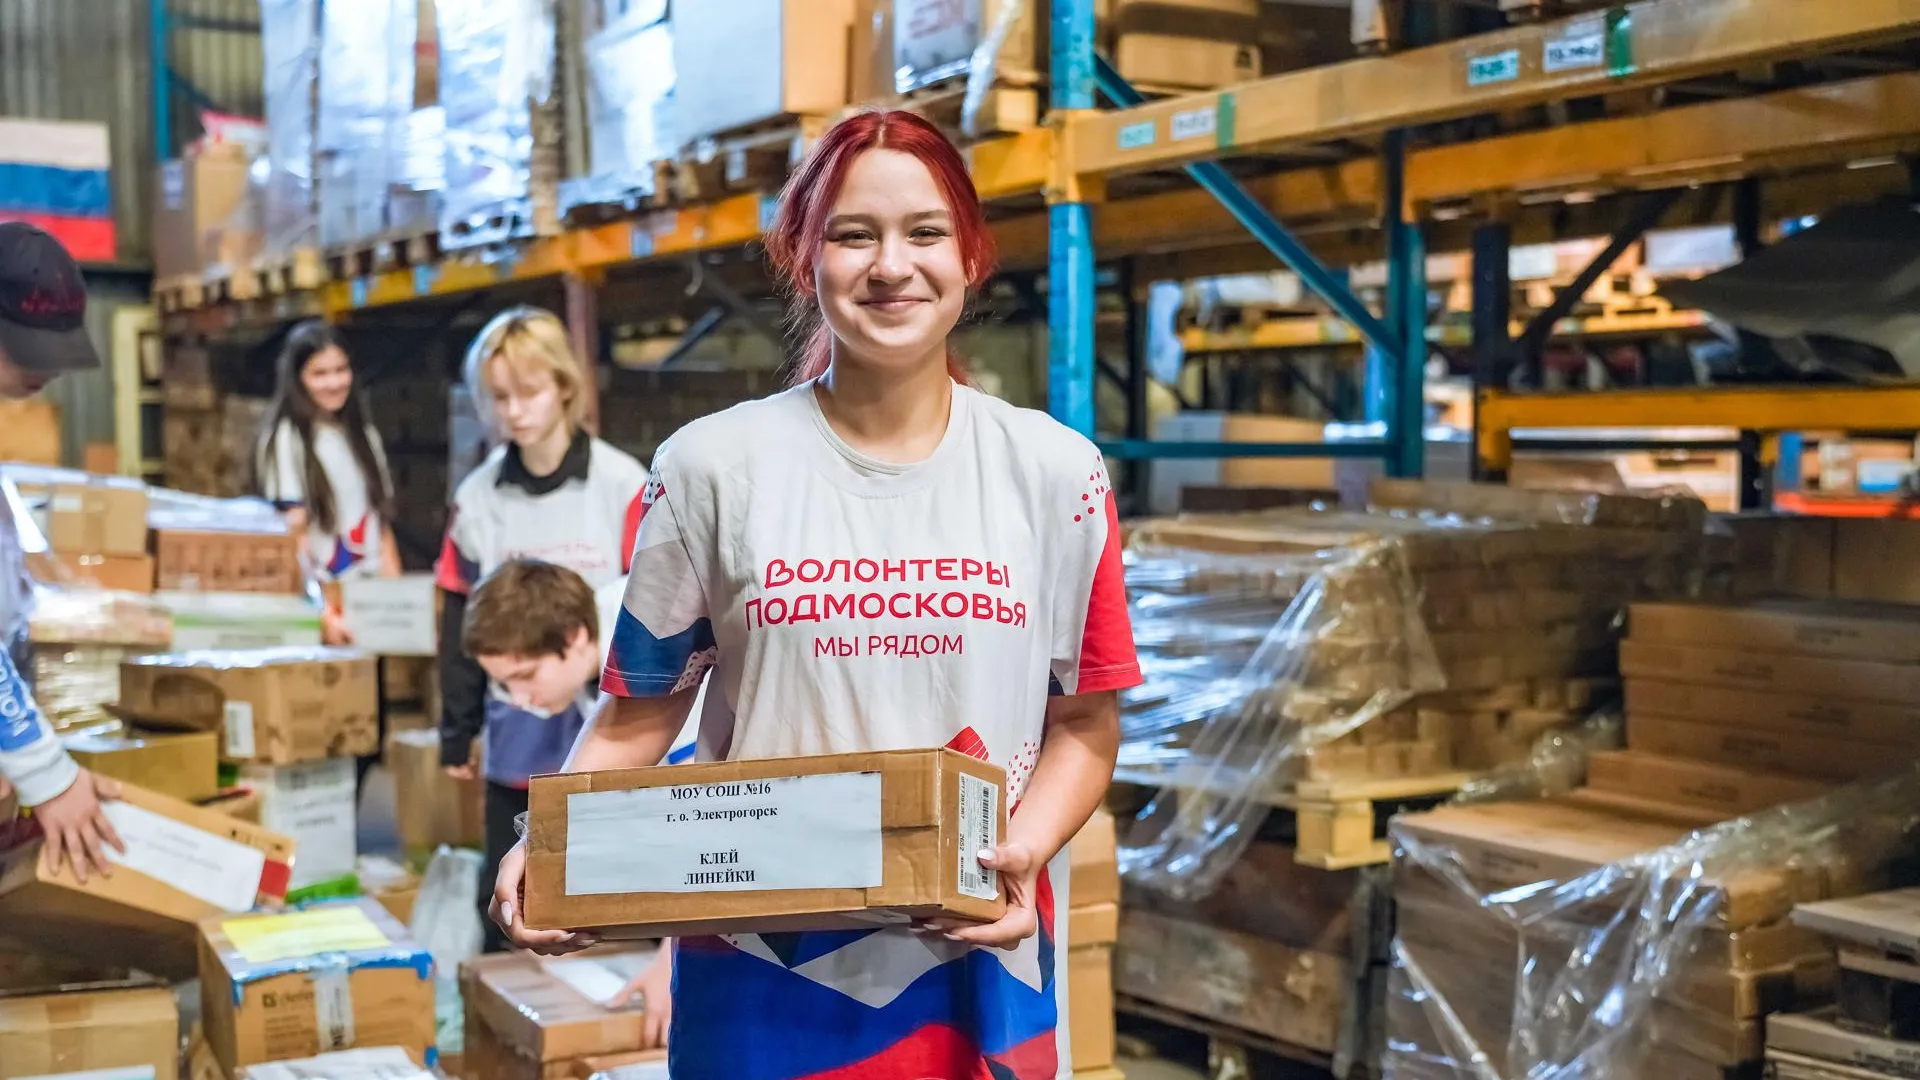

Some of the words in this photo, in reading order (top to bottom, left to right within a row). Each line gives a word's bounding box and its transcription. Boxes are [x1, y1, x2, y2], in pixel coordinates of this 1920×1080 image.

[764, 557, 1011, 589] ВОЛОНТЕРЫ
[744, 591, 1027, 631] ПОДМОСКОВЬЯ
[814, 635, 859, 658] МЫ
[868, 634, 963, 659] РЯДОМ
[671, 787, 703, 800] МОУ
[706, 785, 741, 798] СОШ
[743, 782, 771, 796] №16
[667, 814, 676, 822] г.
[680, 812, 689, 822] о.
[692, 807, 778, 821] Электрогорск
[699, 848, 739, 865] КЛЕЙ
[683, 868, 756, 885] ЛИНЕЙКИ
